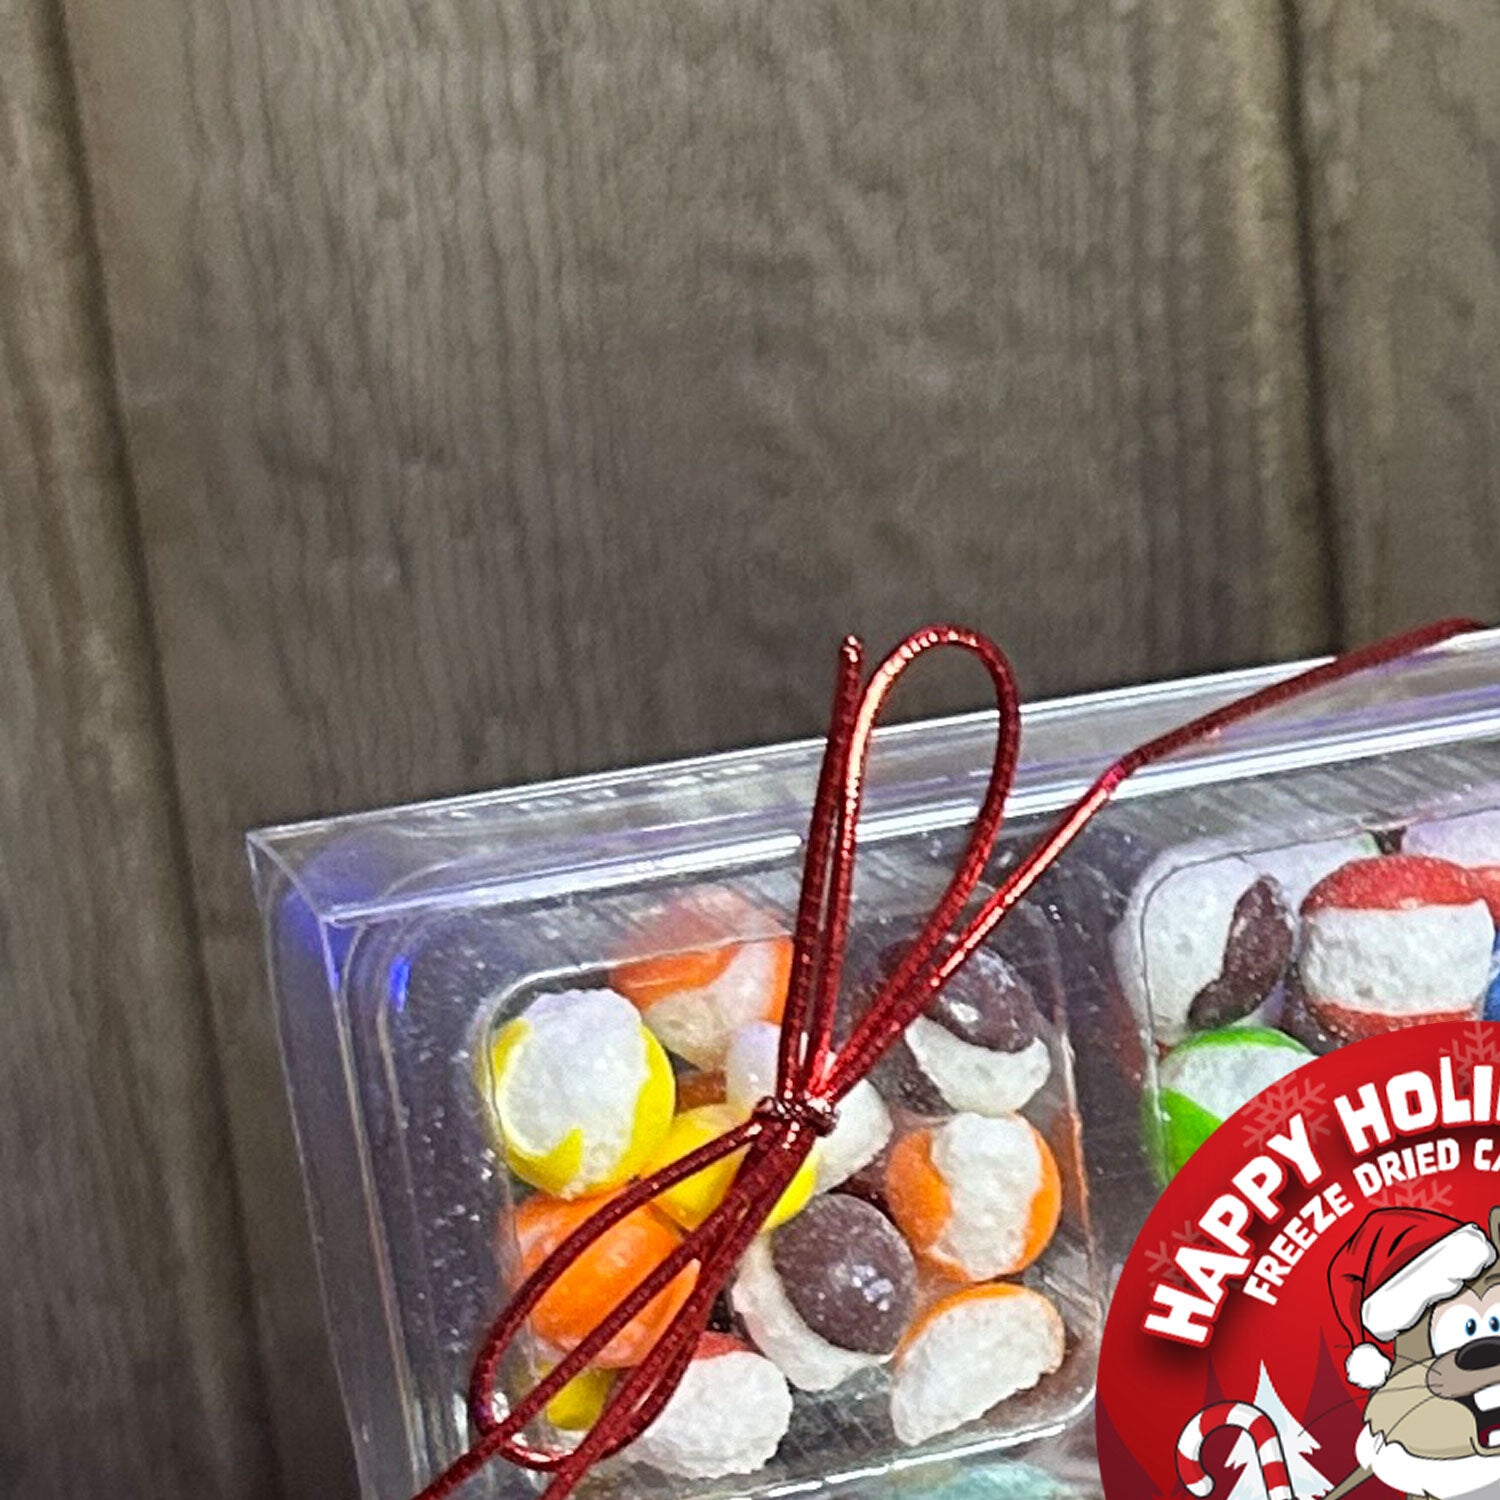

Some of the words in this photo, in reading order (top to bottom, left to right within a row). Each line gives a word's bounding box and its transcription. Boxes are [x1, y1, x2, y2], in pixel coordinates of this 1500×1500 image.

[1144, 1113, 1324, 1344] HAPPY
[1243, 1183, 1354, 1305] FREEZE
[1354, 1138, 1460, 1199] DRIED
